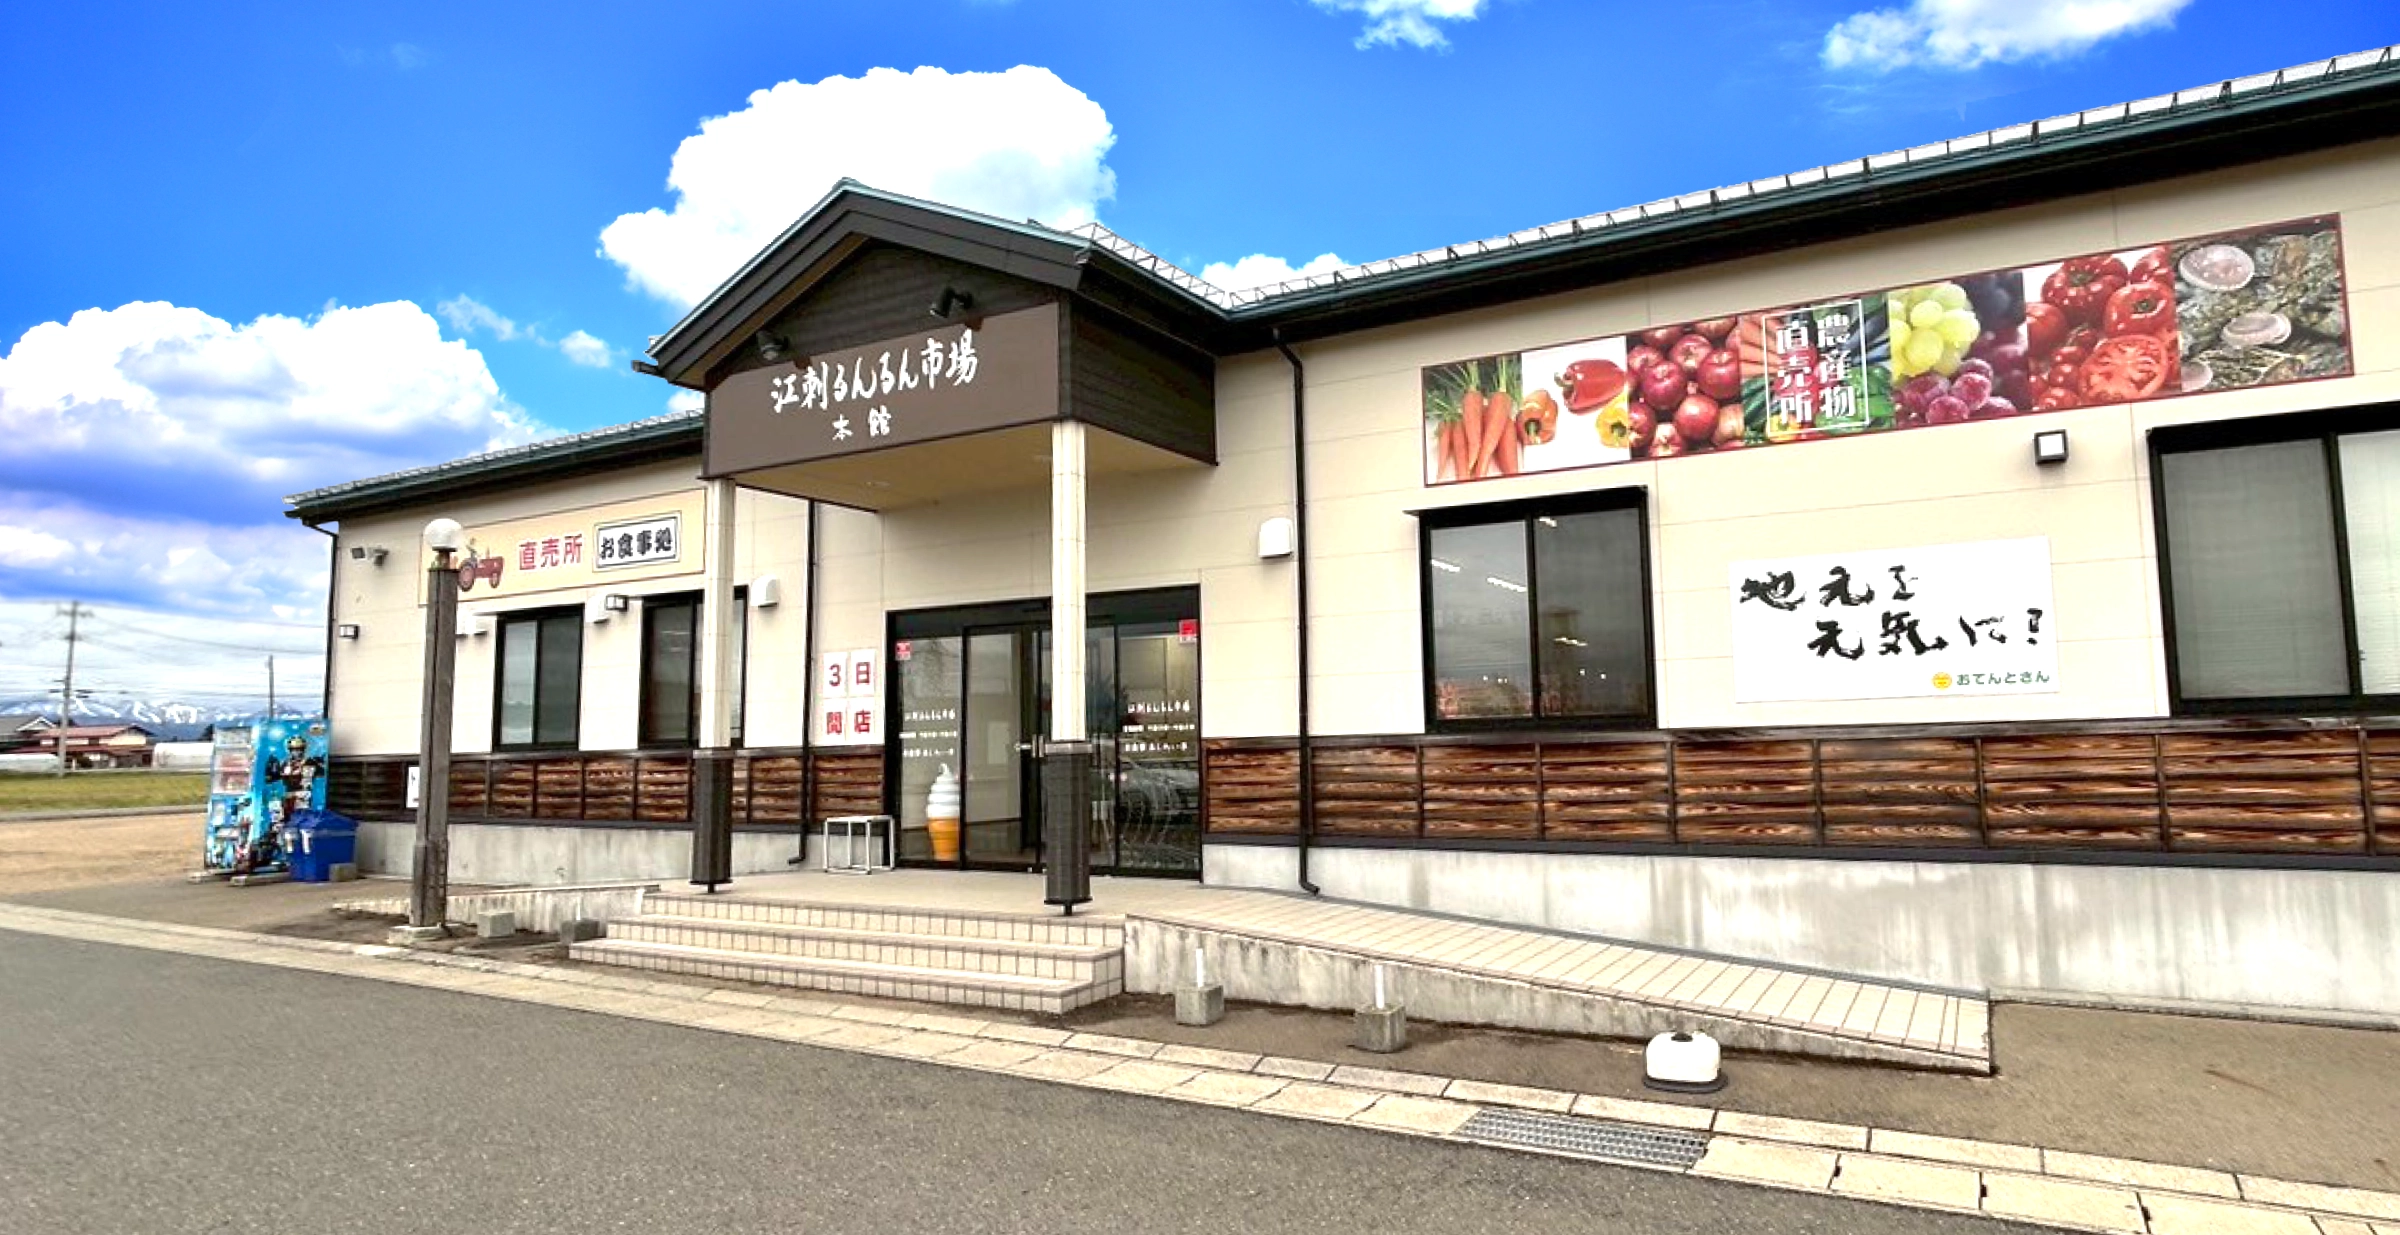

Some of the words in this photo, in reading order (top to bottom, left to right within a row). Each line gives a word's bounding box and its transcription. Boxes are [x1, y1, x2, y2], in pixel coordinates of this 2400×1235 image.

[770, 328, 979, 413] 江刺るんるん市場
[1775, 319, 1812, 424] 直売所
[1816, 313, 1855, 418] 農産物
[832, 404, 892, 441] 本館
[518, 533, 583, 571] 直売所
[600, 526, 673, 559] お食事処
[1739, 564, 1919, 612] 地元を
[1956, 670, 2050, 686] おてんとさん
